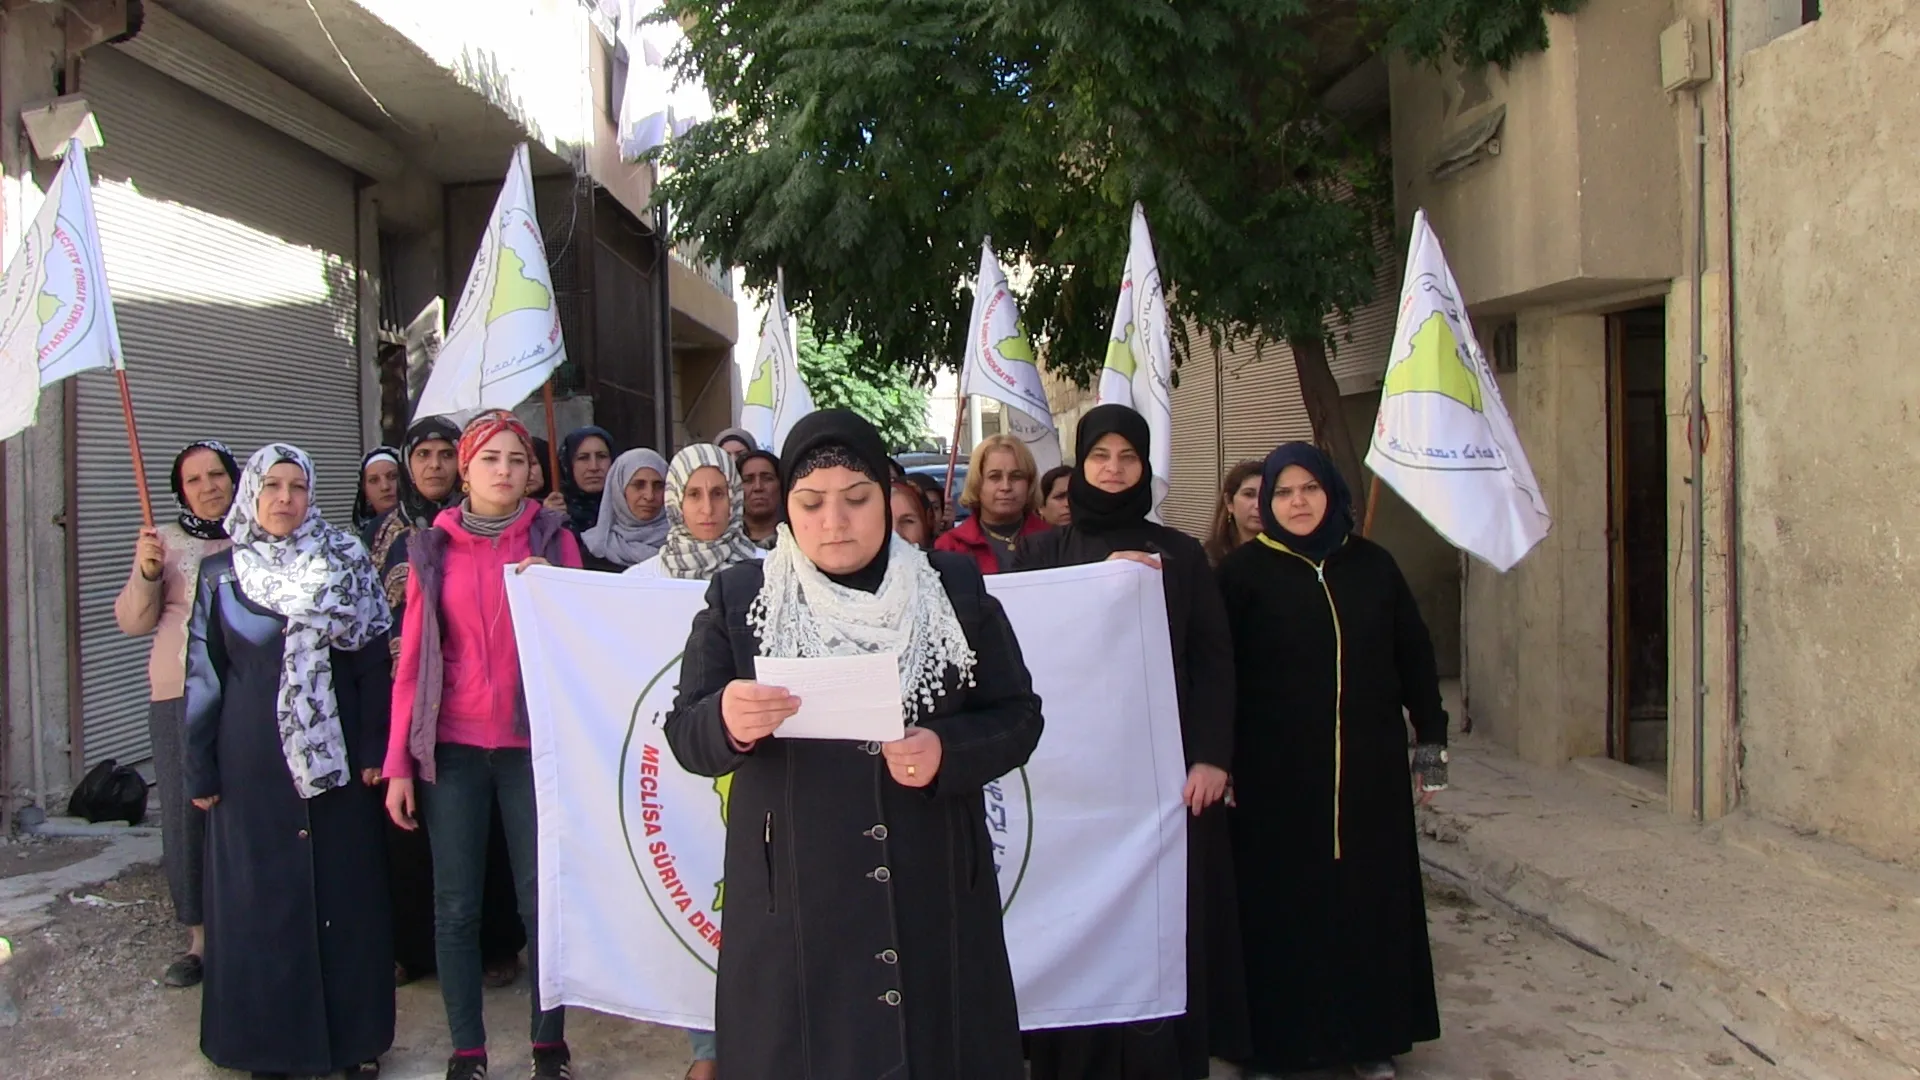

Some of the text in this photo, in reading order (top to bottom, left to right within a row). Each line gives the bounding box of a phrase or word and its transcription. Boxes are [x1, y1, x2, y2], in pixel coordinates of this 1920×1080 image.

[640, 743, 724, 951] MECLÎSA SÛRIYA DEM
